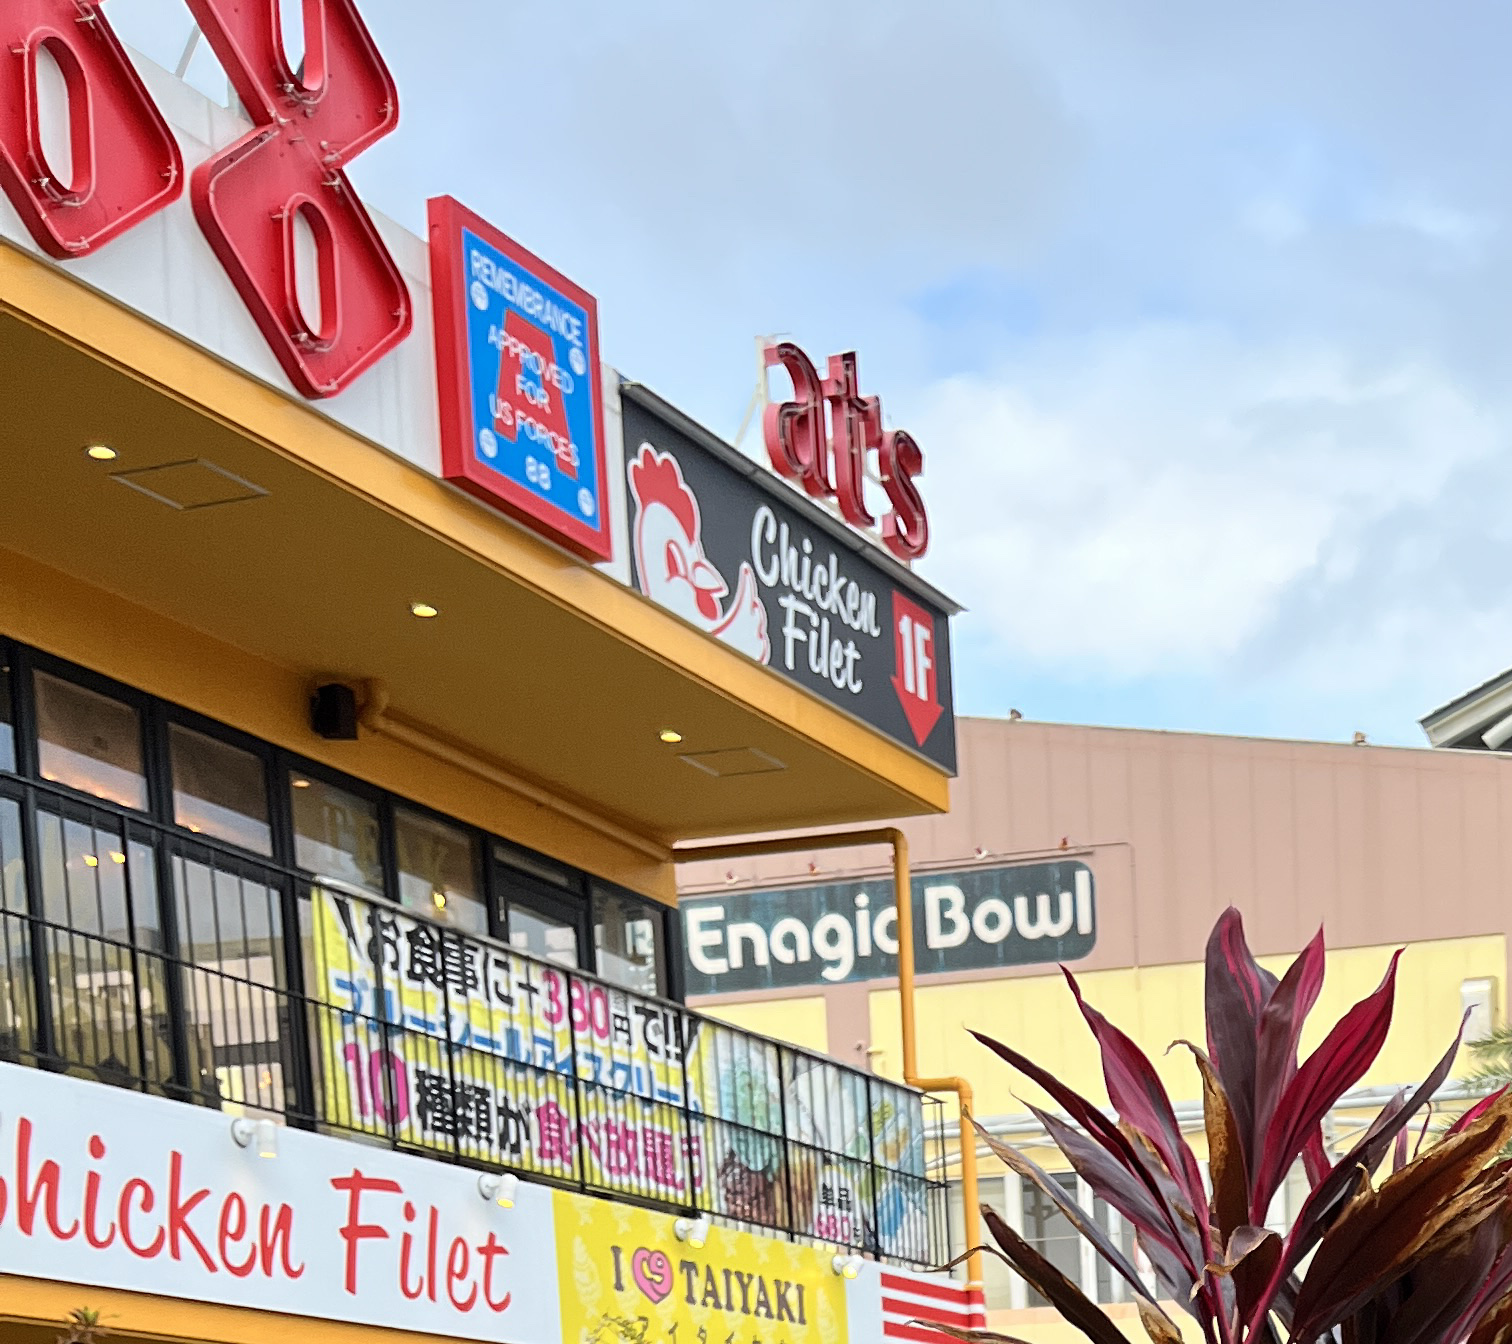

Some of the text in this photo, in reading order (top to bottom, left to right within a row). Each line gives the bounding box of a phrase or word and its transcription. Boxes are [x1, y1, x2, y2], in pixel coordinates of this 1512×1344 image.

[471, 250, 583, 347] REMEMBRANCE
[488, 324, 575, 394] APPROVED
[515, 373, 551, 414] FOR
[489, 393, 581, 468] US FORCES
[526, 455, 551, 491] 88
[751, 505, 881, 638] Chicken
[778, 594, 863, 695] Filet
[899, 614, 932, 702] 1F
[924, 869, 1093, 950] Bowl
[0, 1117, 512, 1313] hicken Filet
[610, 1245, 808, 1326] I TAIYAKI
